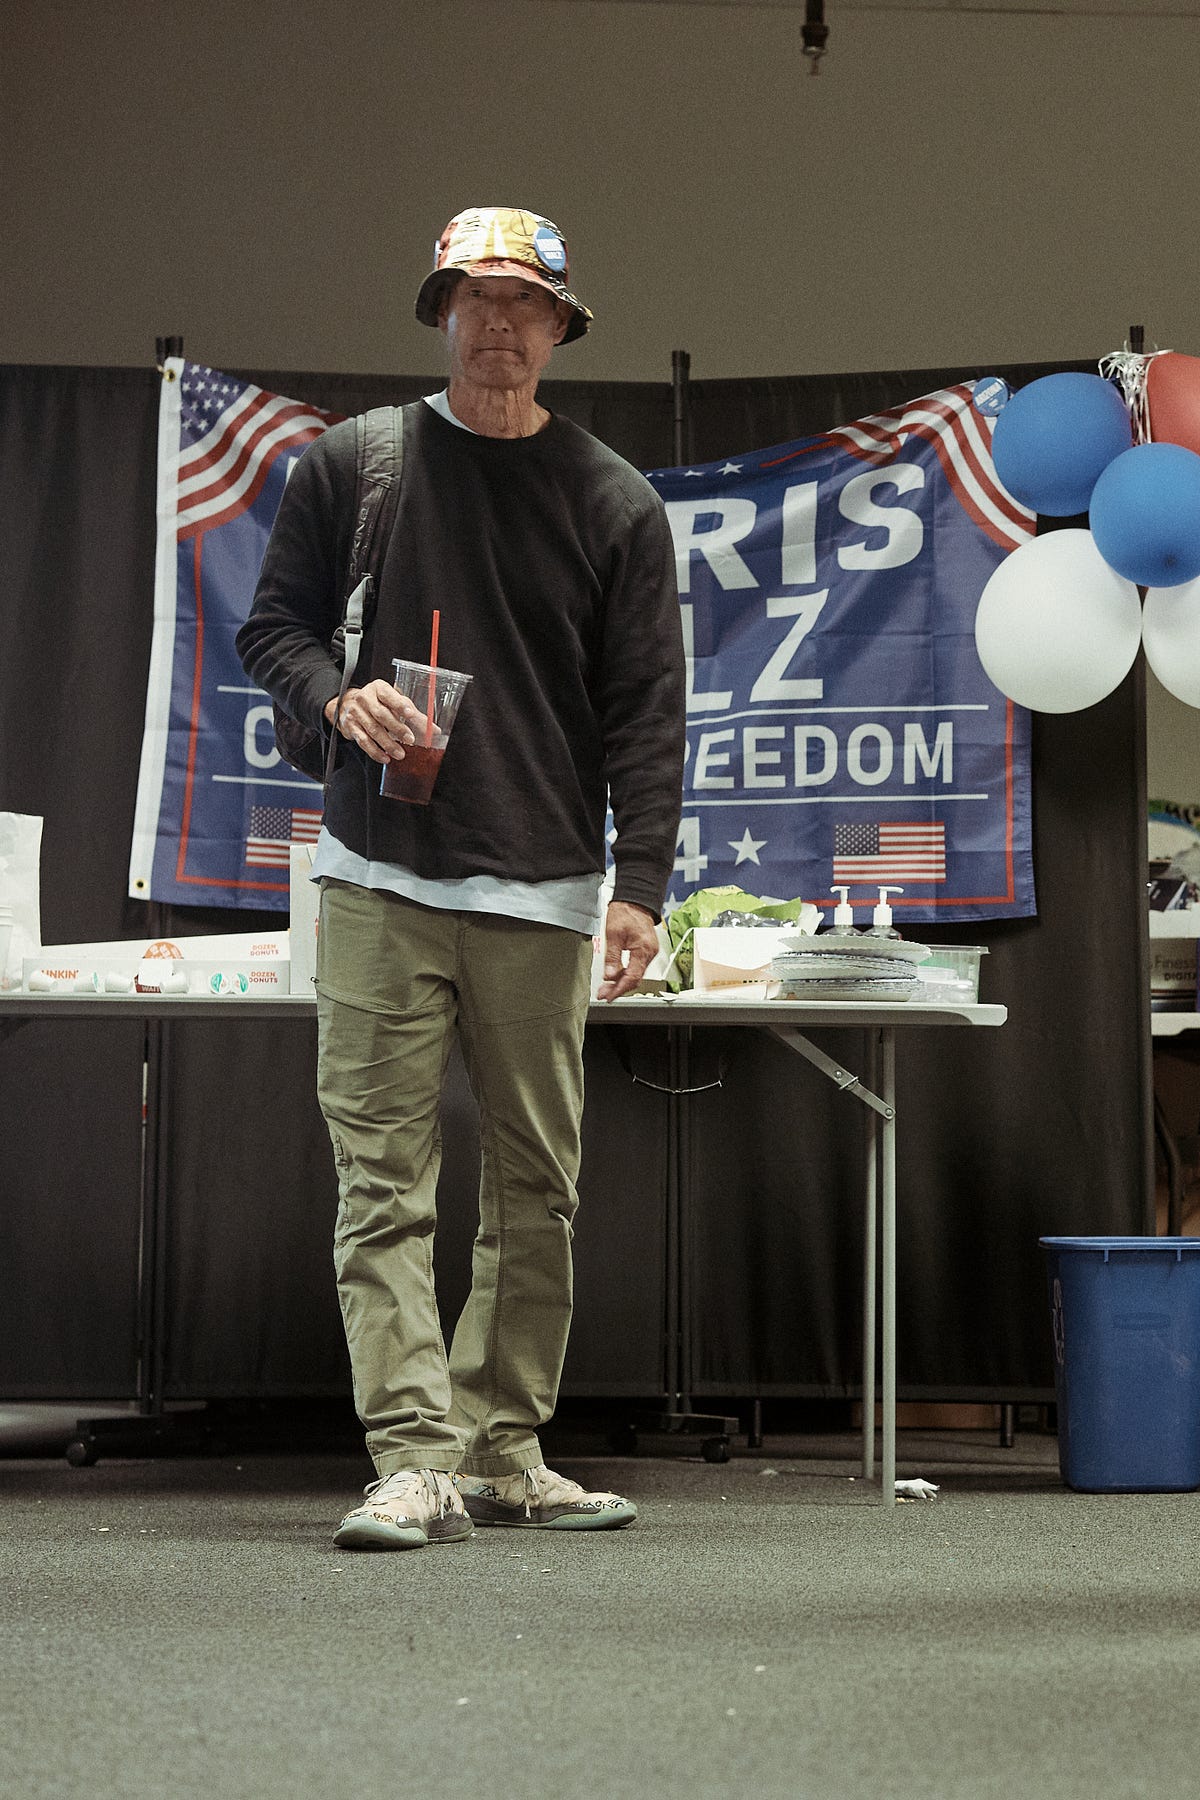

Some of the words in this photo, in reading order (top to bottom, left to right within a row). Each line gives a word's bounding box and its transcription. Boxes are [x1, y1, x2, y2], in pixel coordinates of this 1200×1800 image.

[664, 462, 925, 594] RIS
[679, 588, 830, 713] LZ
[682, 721, 953, 790] EEDOM
[252, 943, 277, 951] DOZEN
